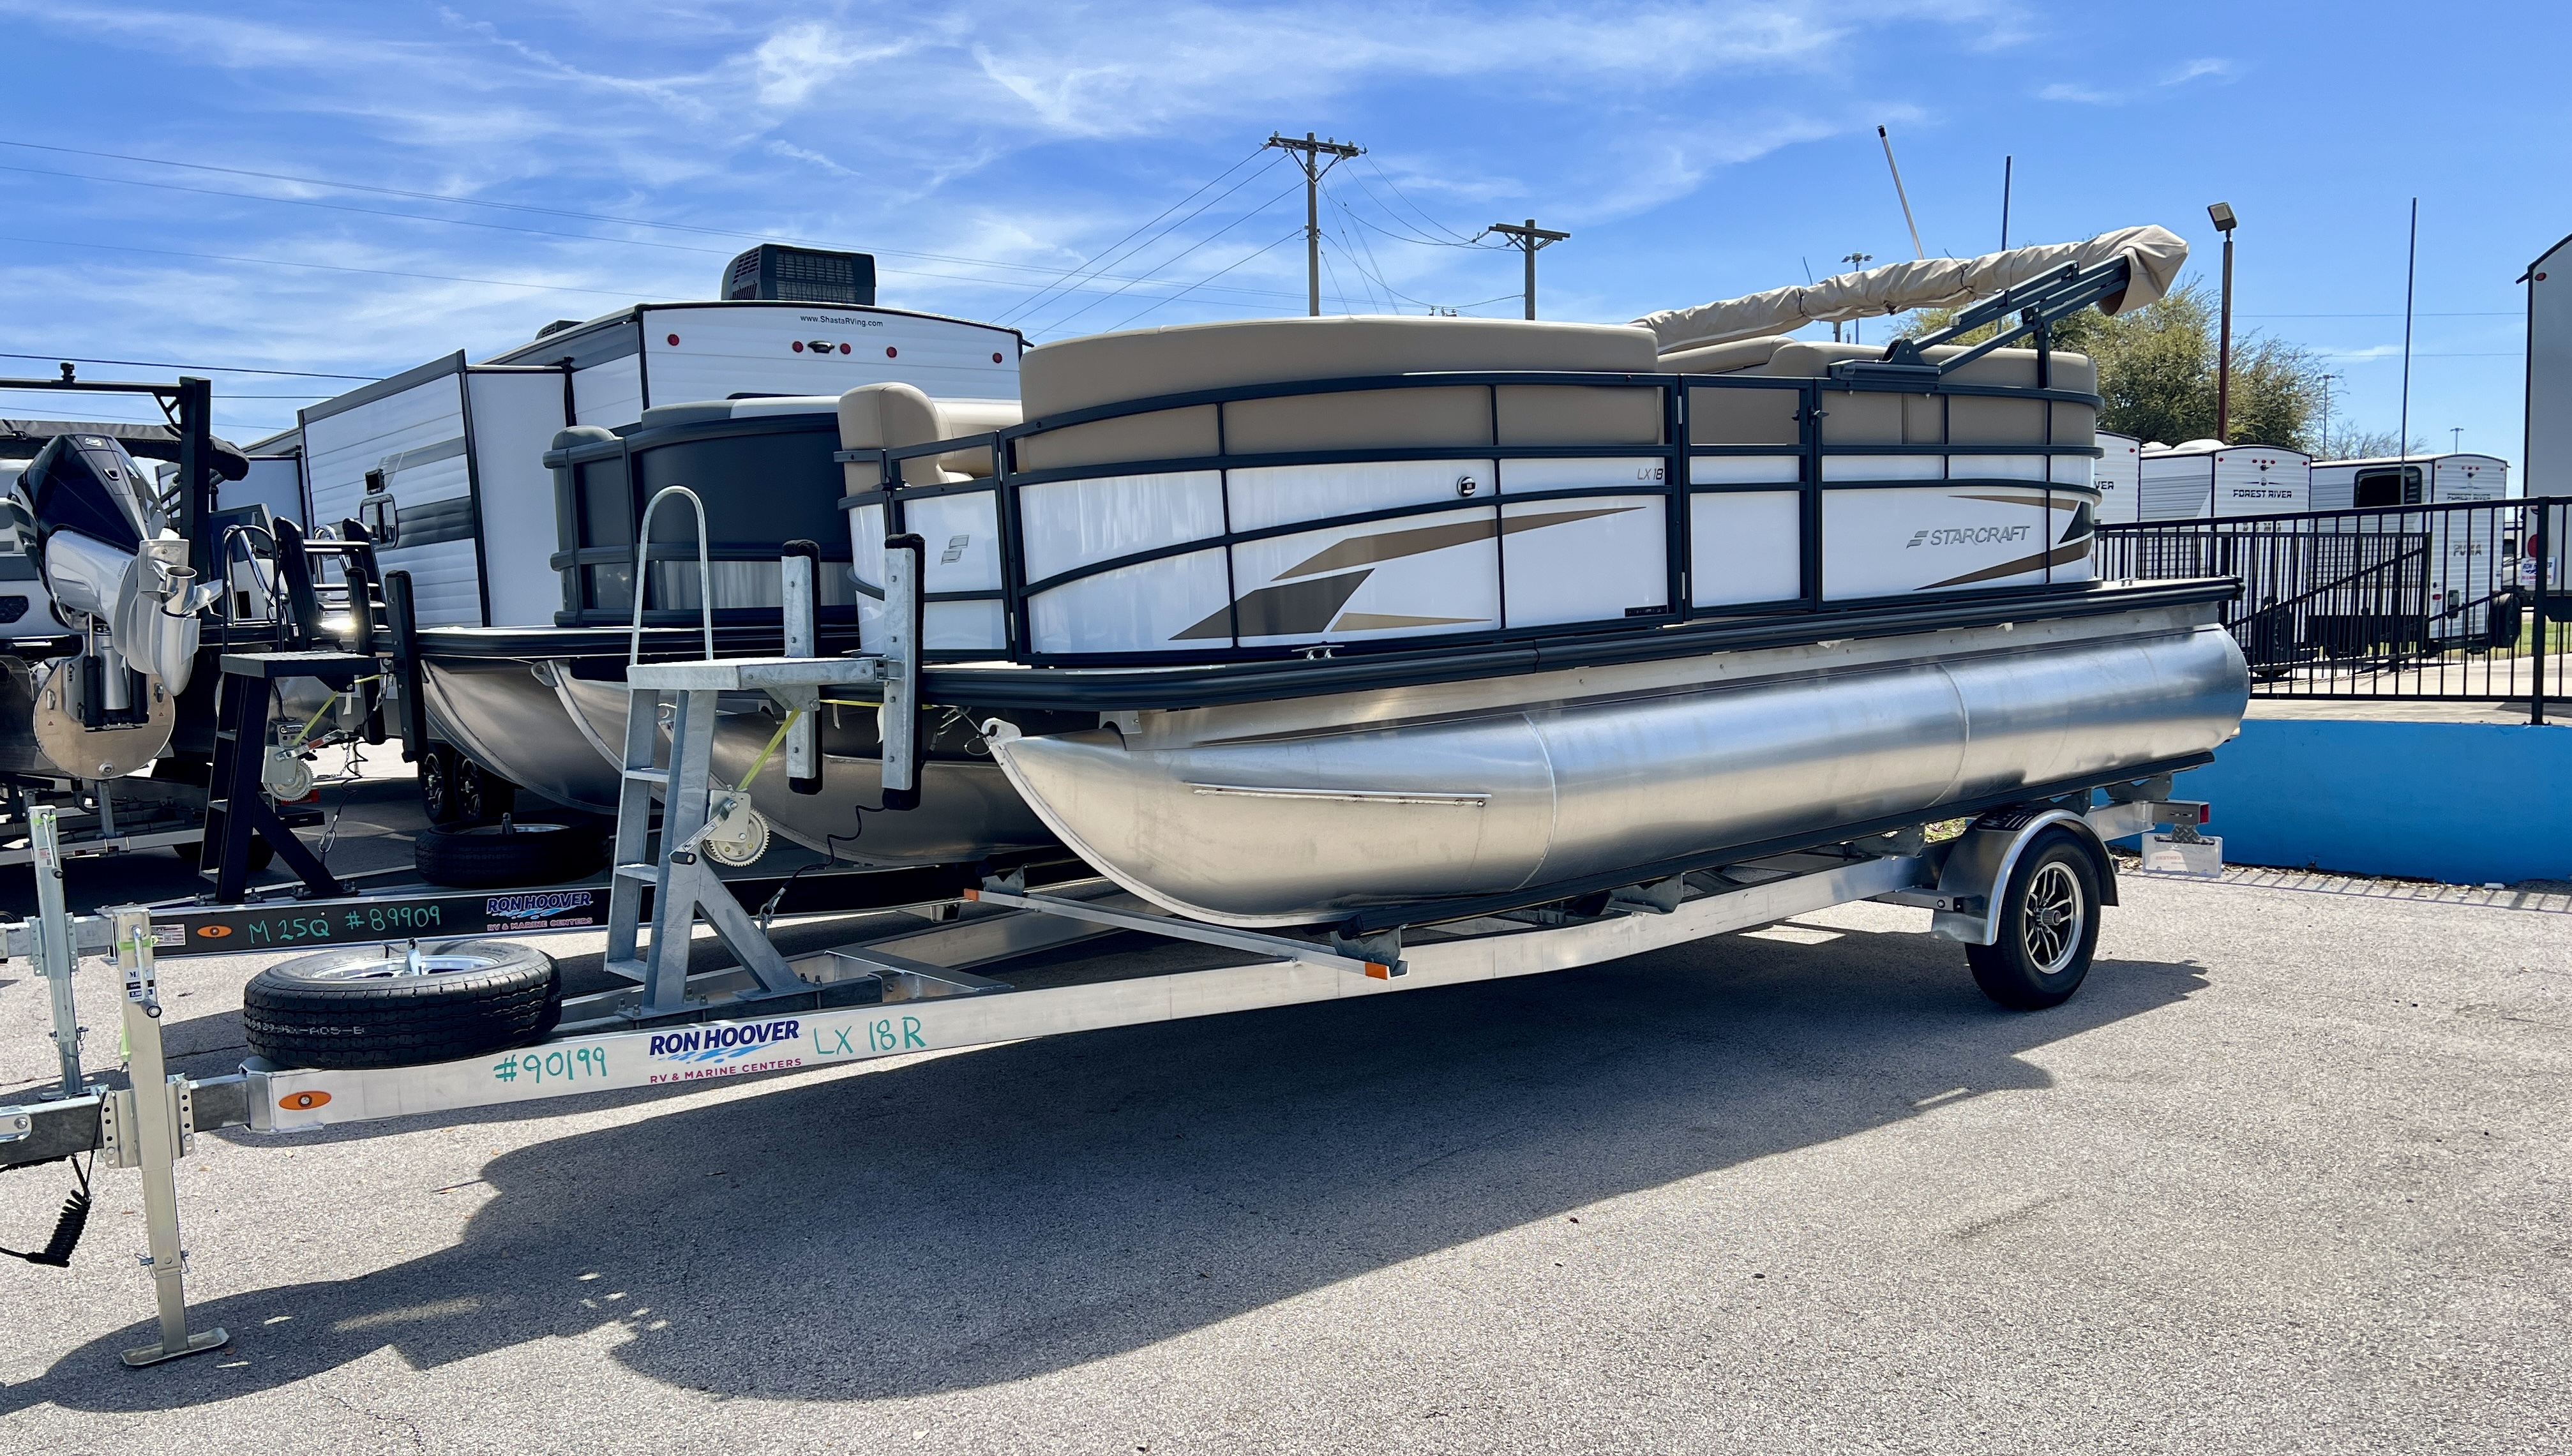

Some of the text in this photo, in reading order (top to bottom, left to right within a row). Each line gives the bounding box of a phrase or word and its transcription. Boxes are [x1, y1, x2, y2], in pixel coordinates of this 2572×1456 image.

[800, 315, 884, 327] www.ShastaRVing.com
[2094, 481, 2114, 490] VER
[2233, 490, 2266, 498] FOREST
[1930, 525, 2031, 545] STARCRAFT
[486, 892, 592, 913] RON HOOVER
[248, 920, 271, 944] M
[511, 920, 548, 929] MARINE
[550, 917, 593, 927] CENTERS
[649, 1020, 799, 1055] RON HOOVER
[493, 1047, 607, 1083] #90199
[813, 1026, 854, 1054] LX
[650, 1074, 668, 1083] RV
[685, 1066, 736, 1079] MARINE
[742, 1058, 802, 1072] CENTERS
